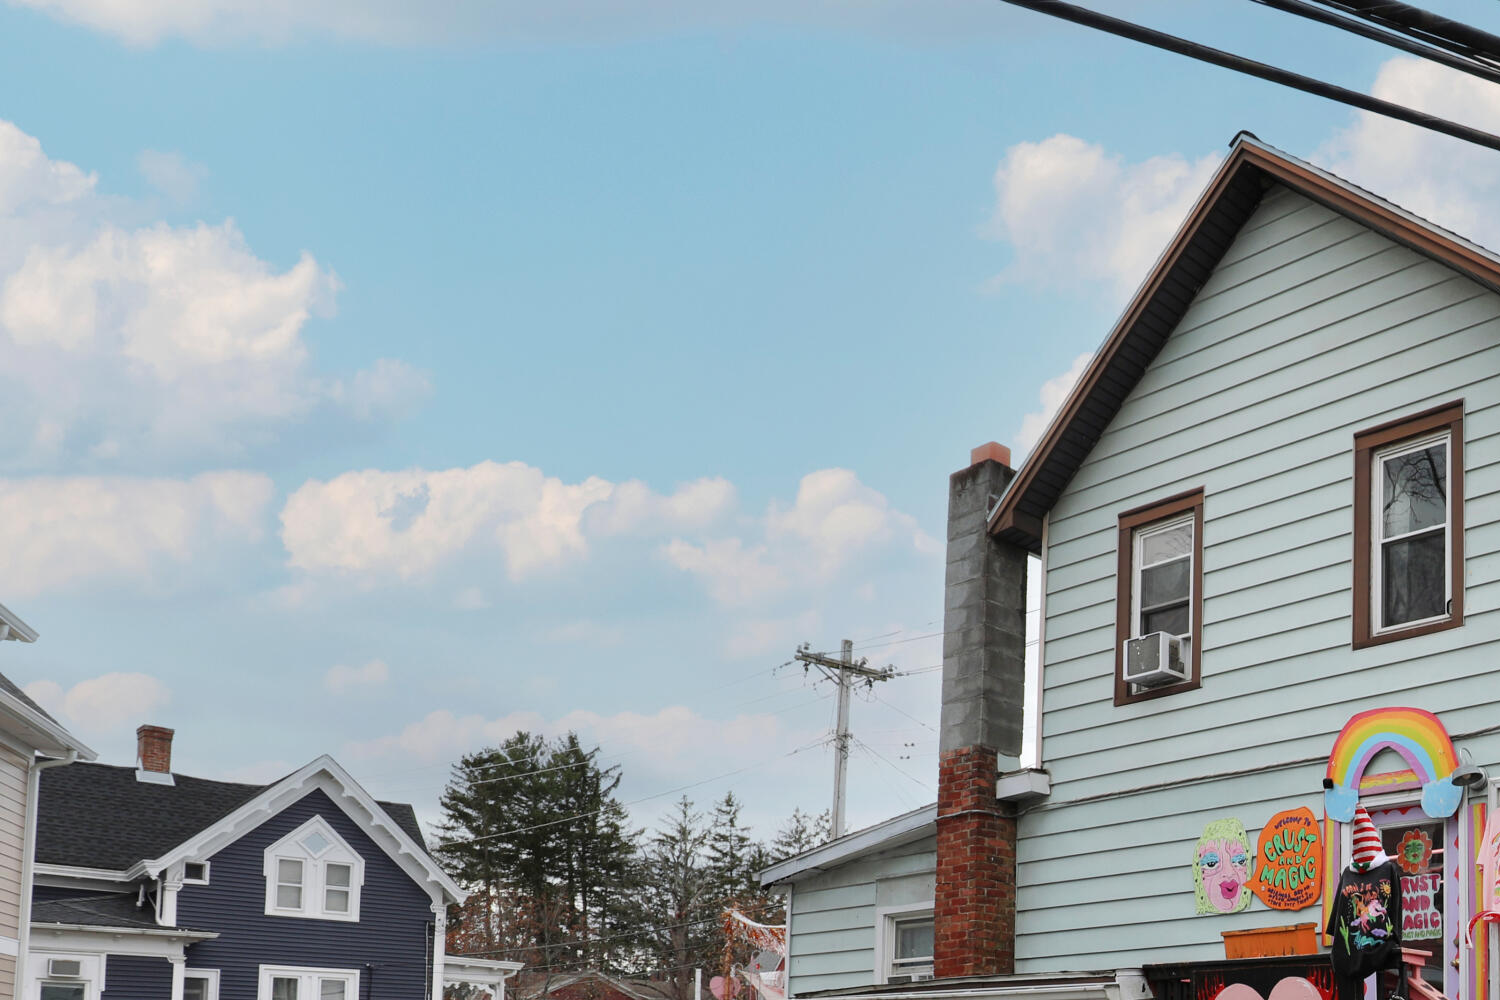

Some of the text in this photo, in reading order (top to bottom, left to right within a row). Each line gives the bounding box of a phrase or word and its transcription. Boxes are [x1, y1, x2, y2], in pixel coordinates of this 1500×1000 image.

[1274, 816, 1311, 829] WELCOME TO
[1264, 828, 1317, 862] CRUST
[1278, 855, 1301, 866] AND
[1260, 857, 1316, 890] MAGIC
[1400, 874, 1440, 894] RUST
[1402, 911, 1441, 931] AGIC
